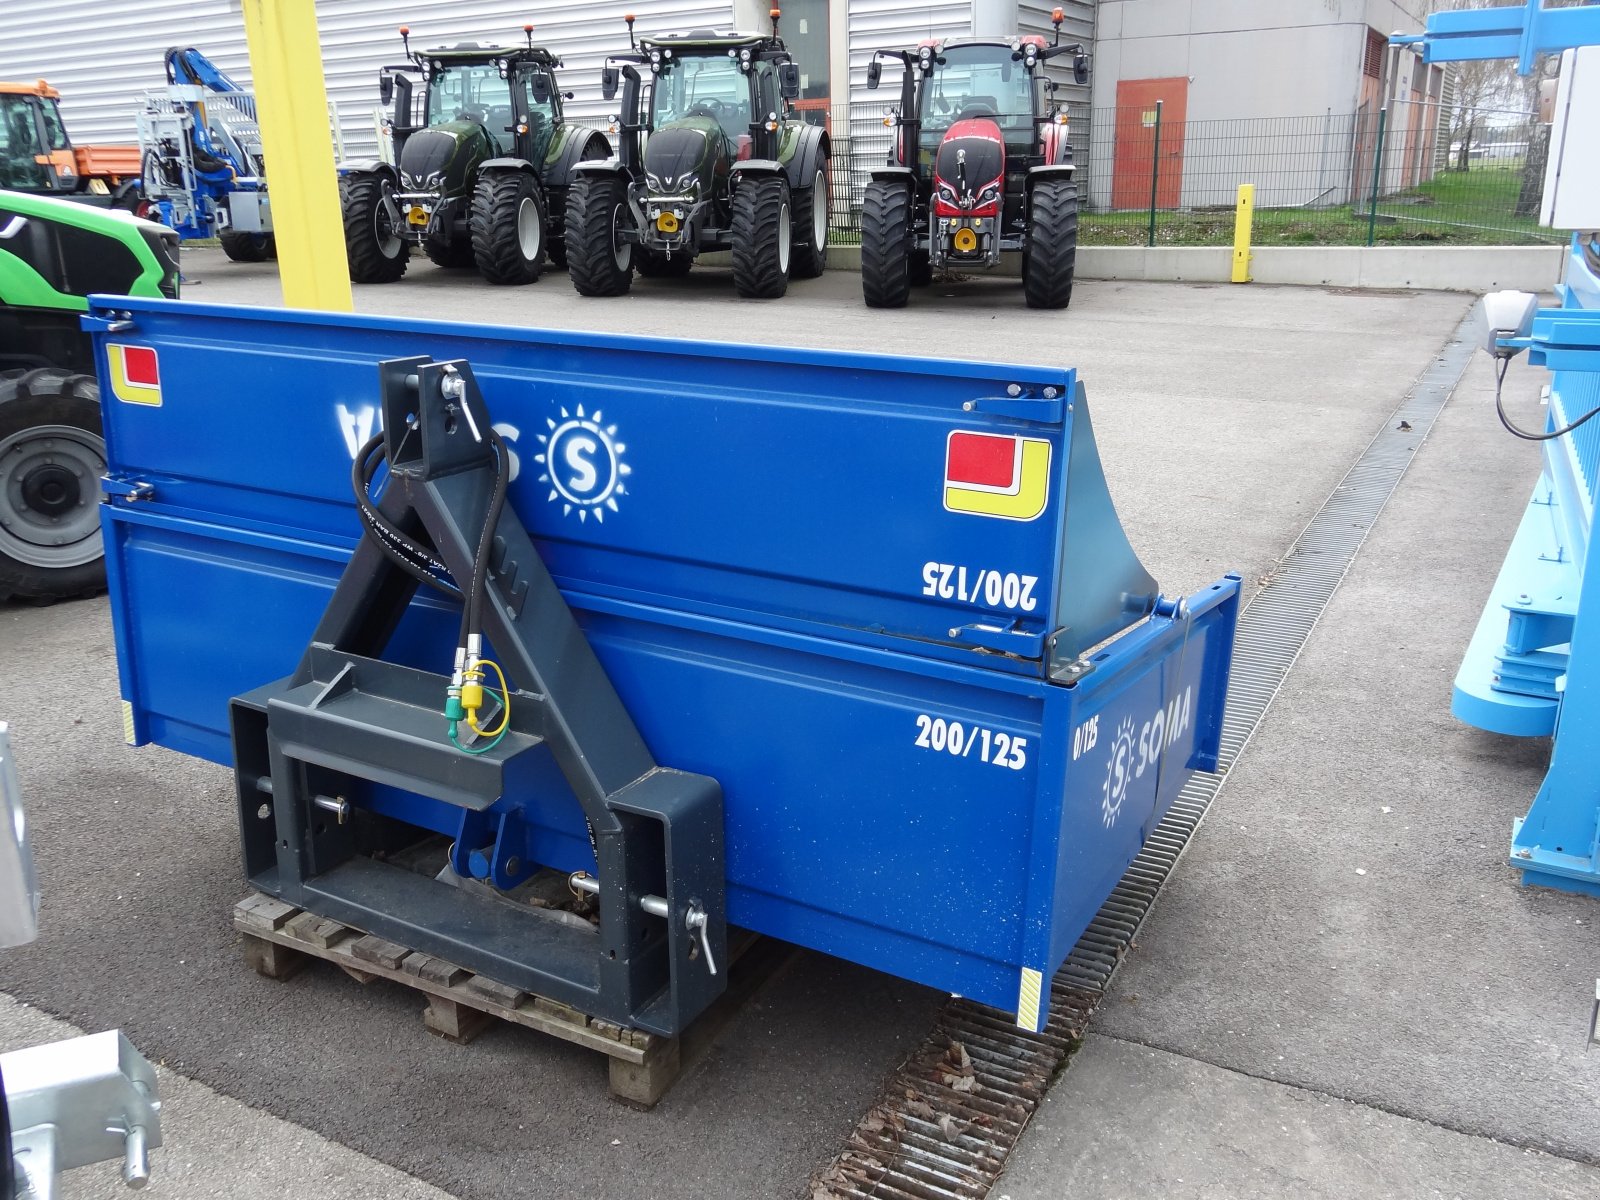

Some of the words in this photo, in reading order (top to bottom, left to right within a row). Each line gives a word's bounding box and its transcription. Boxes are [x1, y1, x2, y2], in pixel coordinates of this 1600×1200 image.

[375, 521, 389, 535] BAR
[922, 561, 1039, 611] 200/125
[914, 714, 1027, 770] 200/125
[1136, 684, 1191, 779] SOMA
